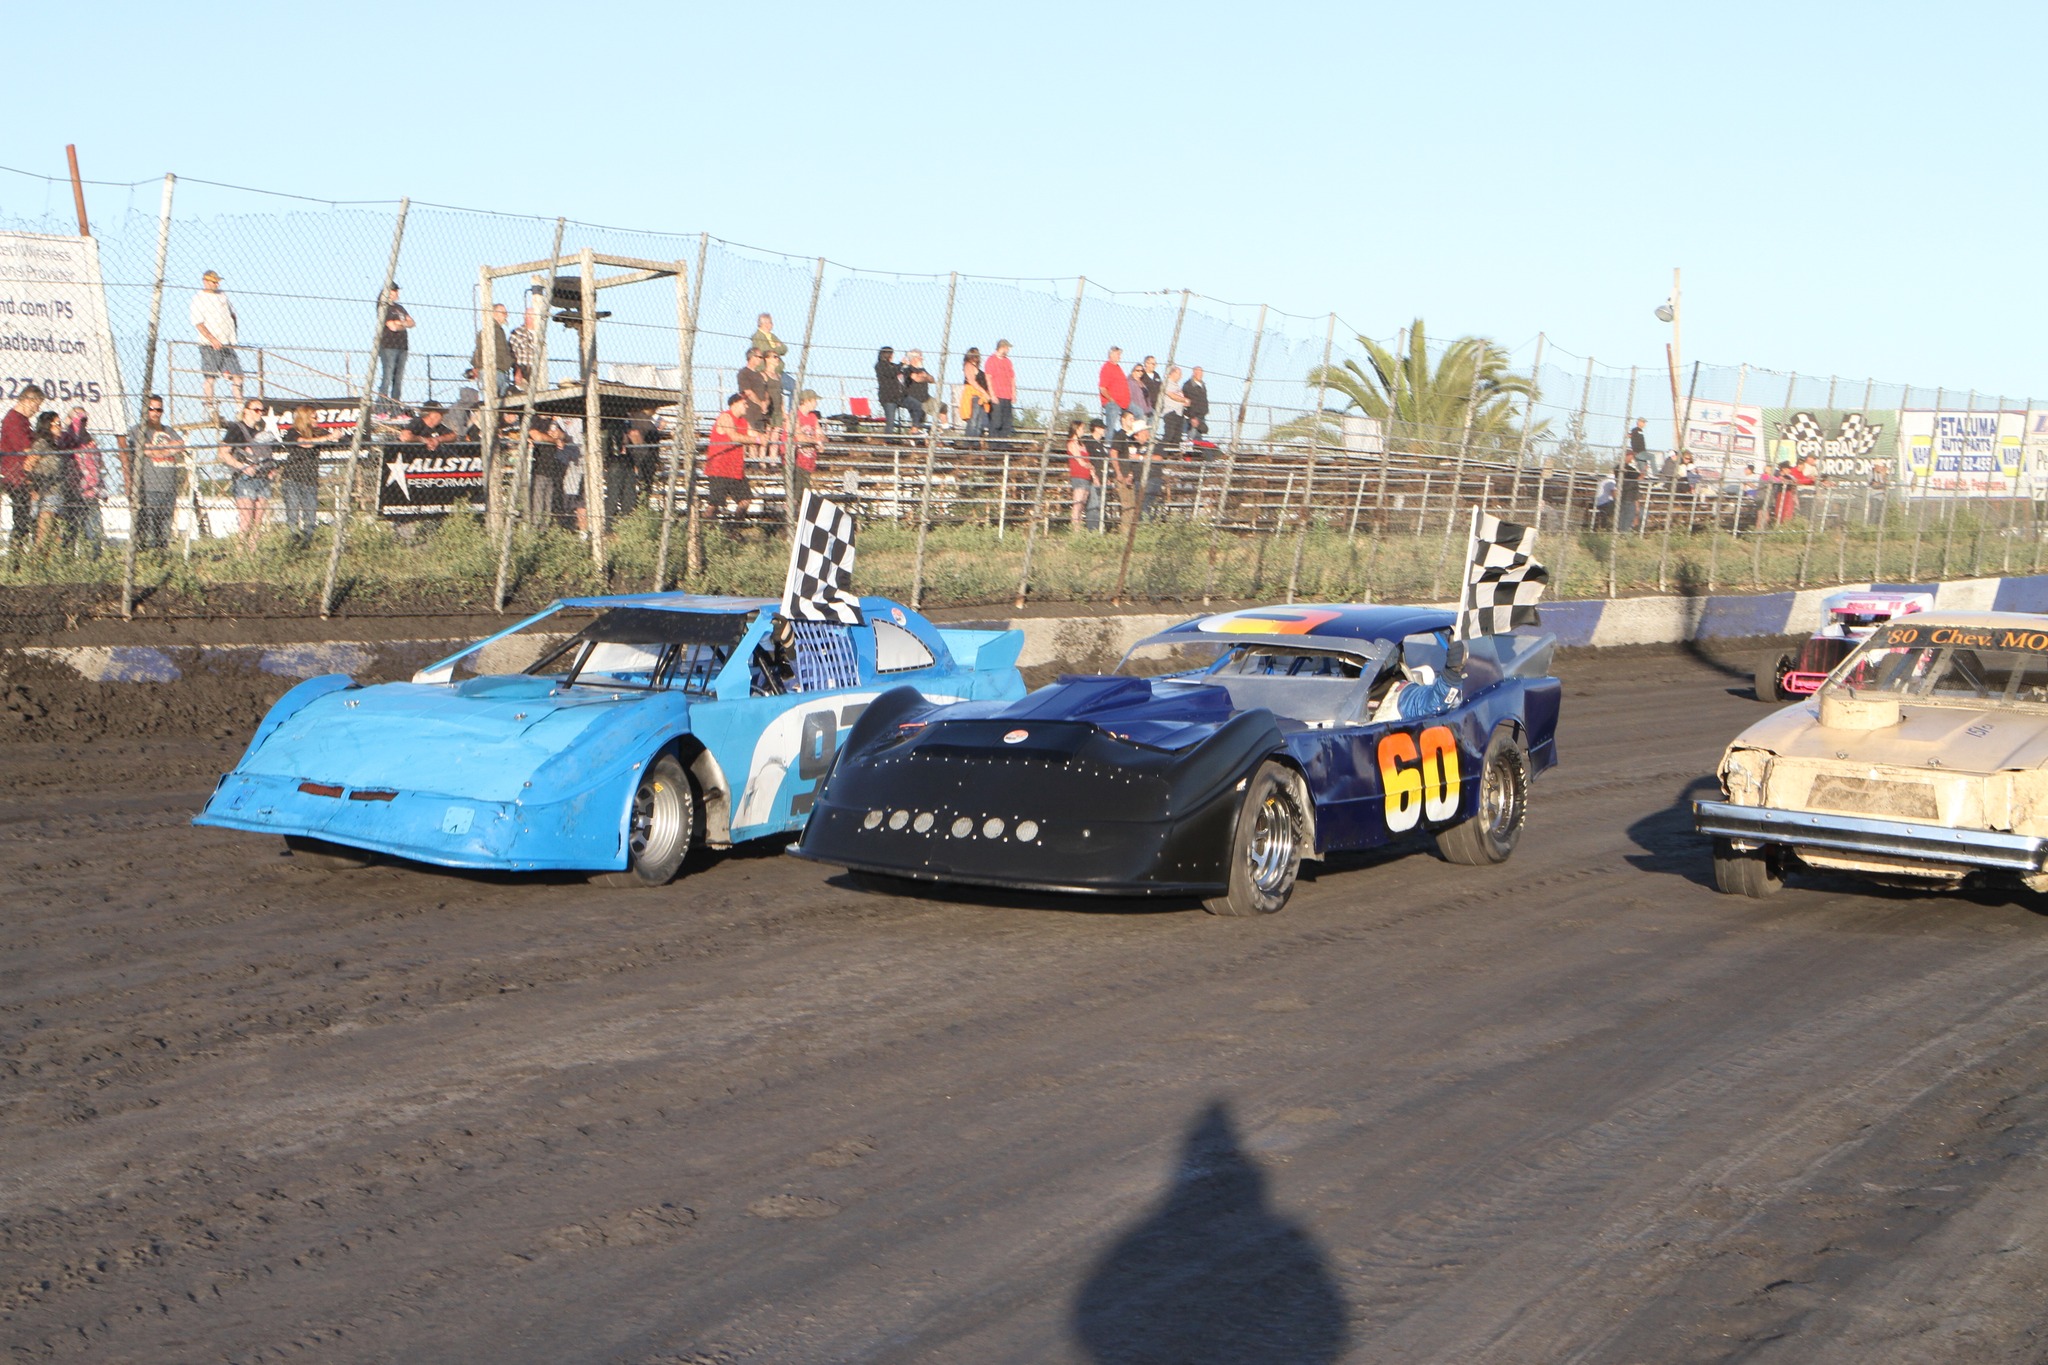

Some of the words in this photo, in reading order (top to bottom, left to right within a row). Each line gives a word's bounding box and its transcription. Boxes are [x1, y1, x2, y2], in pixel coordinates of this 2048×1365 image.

[406, 457, 484, 472] ALLSTA
[1887, 629, 1918, 644] '80
[1931, 629, 1992, 646] Chev.
[1378, 726, 1461, 833] 60
